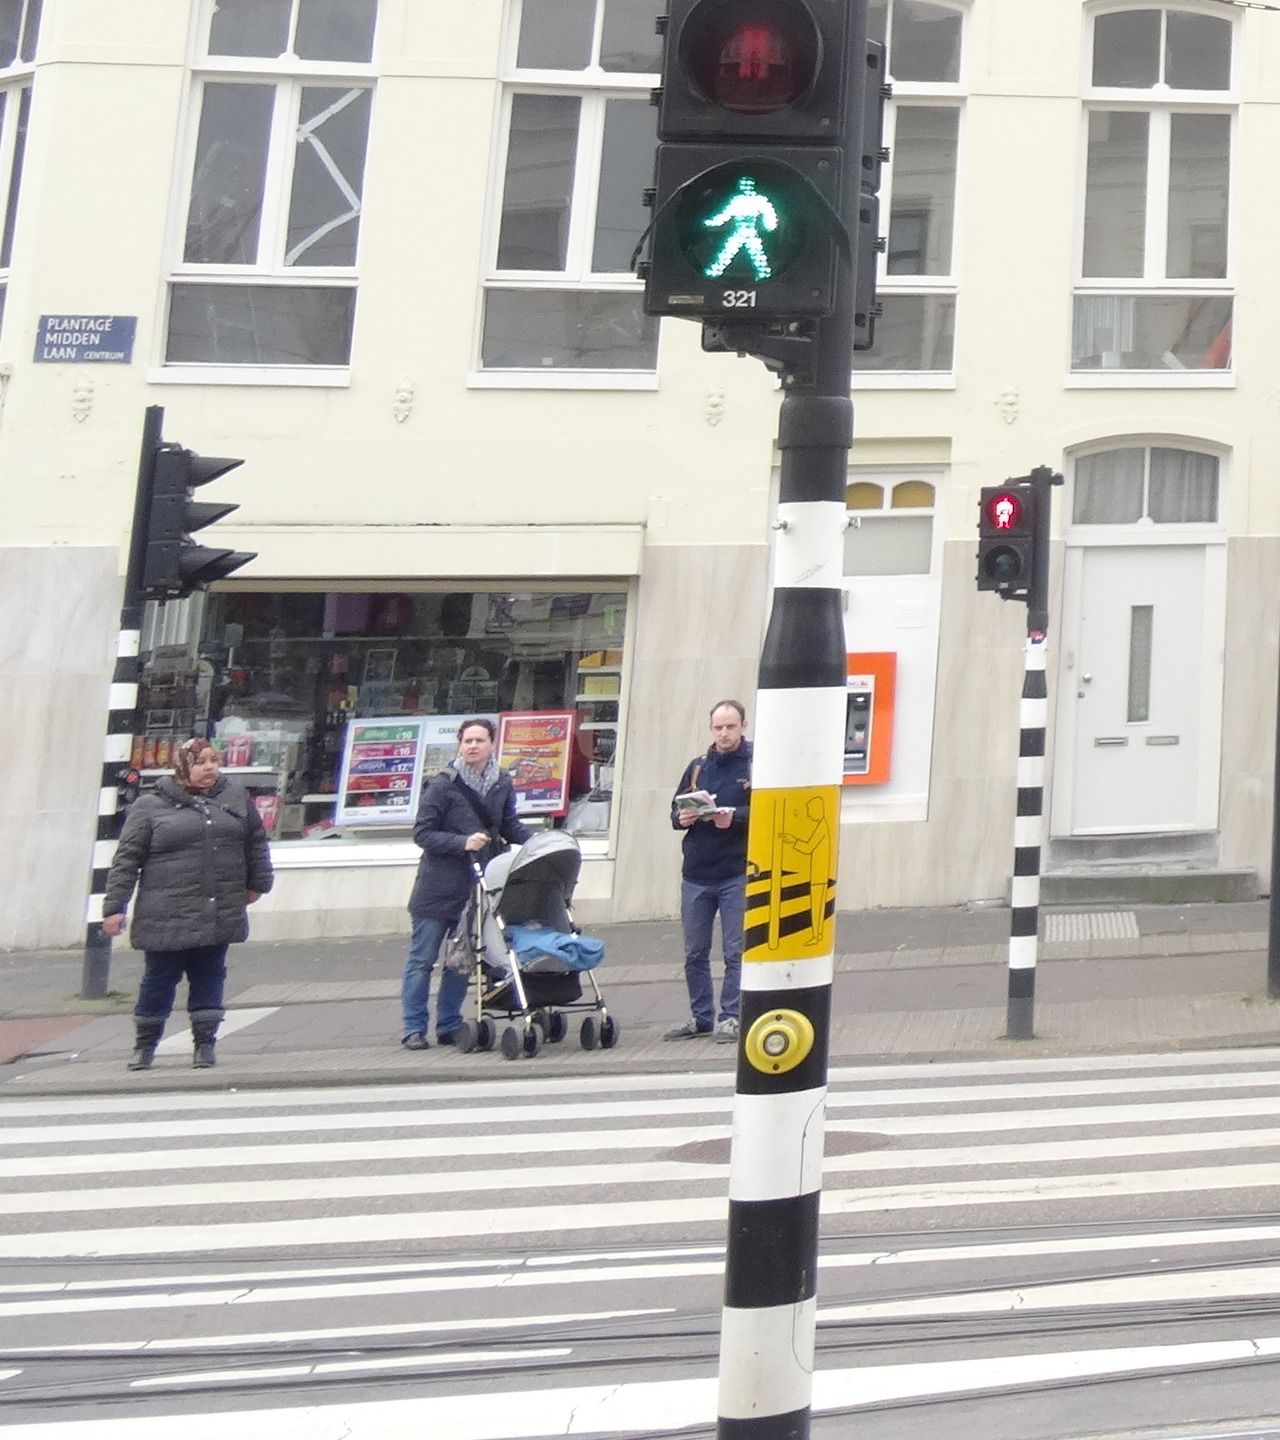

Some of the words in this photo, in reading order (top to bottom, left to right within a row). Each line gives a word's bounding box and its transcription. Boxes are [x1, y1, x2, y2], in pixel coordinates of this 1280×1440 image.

[722, 290, 757, 308] 321
[47, 317, 113, 332] PLANTAGE
[45, 332, 101, 345] MIDDEN
[43, 347, 77, 359] LAAN
[83, 351, 125, 360] CENTRUM
